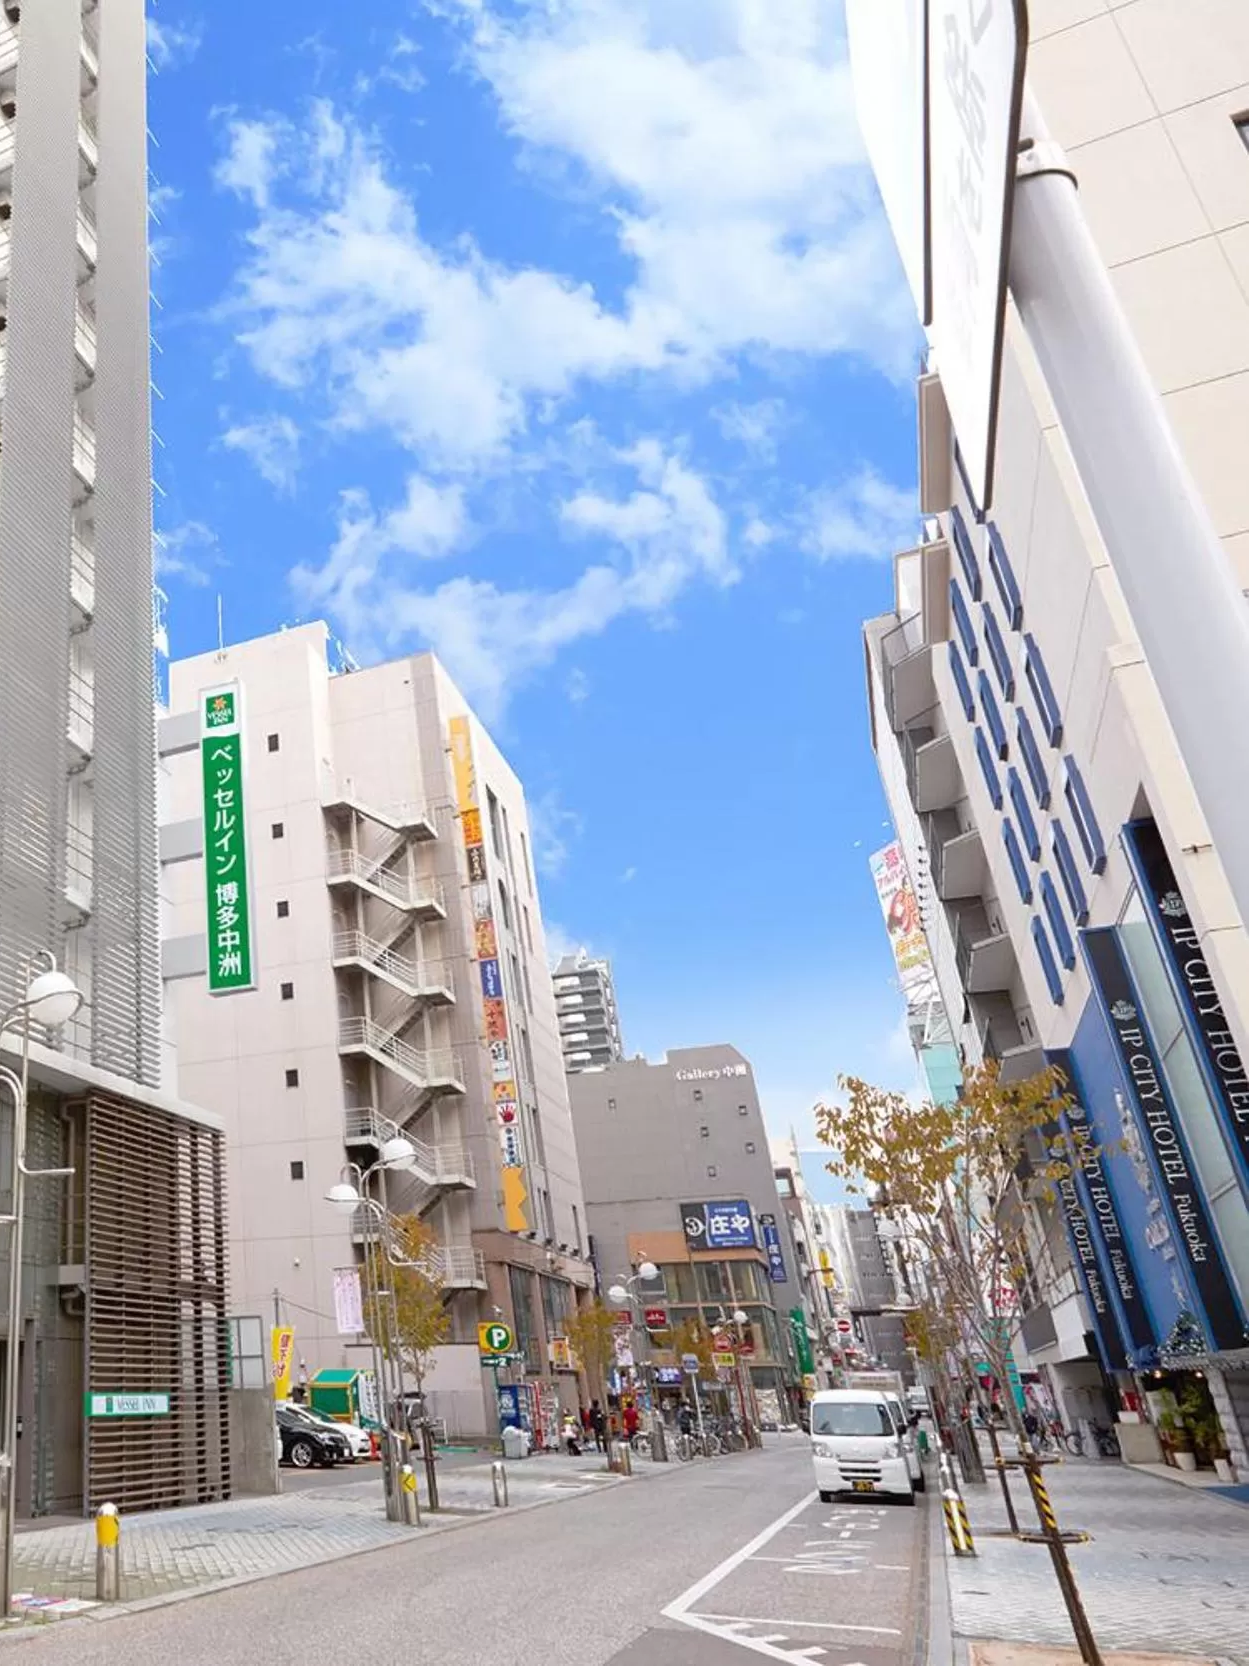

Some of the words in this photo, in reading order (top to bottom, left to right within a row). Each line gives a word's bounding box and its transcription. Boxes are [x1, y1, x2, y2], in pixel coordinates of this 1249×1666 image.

[211, 744, 237, 876] ベッセルイン
[215, 881, 242, 977] 博多中洲
[1171, 926, 1201, 949] IP
[1184, 958, 1224, 1017] CITY
[1120, 1028, 1144, 1049] IP
[1129, 1053, 1163, 1103] CITY
[1146, 1110, 1188, 1185] HOTEL
[710, 1214, 750, 1235] 庄や
[1070, 1215, 1095, 1264] HOTEL
[1091, 1187, 1121, 1242] HOTEL
[1110, 1249, 1133, 1300] Fukuoka
[1174, 1193, 1207, 1263] Fukuoka
[491, 1328, 507, 1348] P
